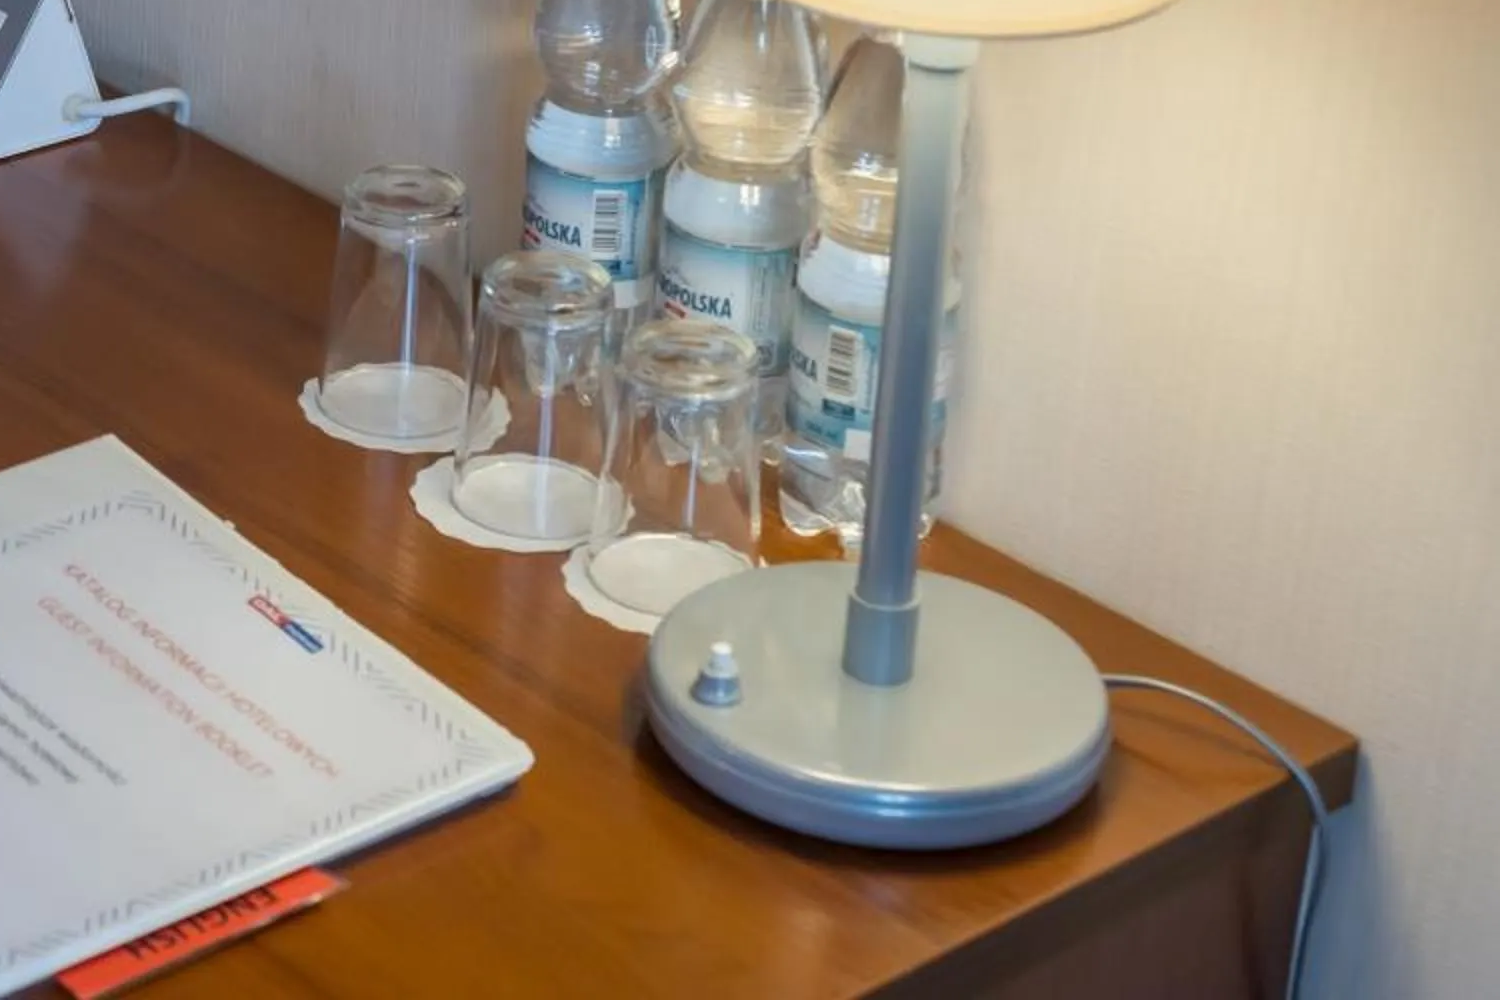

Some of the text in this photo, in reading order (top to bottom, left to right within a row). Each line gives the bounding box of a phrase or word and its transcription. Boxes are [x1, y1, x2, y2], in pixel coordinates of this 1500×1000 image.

[38, 595, 92, 638] GUEST
[88, 636, 197, 724] INFORMATION
[195, 721, 274, 778] BOOKLET
[64, 563, 136, 621] KATALOG
[226, 691, 339, 778] HOTELOWYCH
[127, 886, 278, 960] ENGLISH
